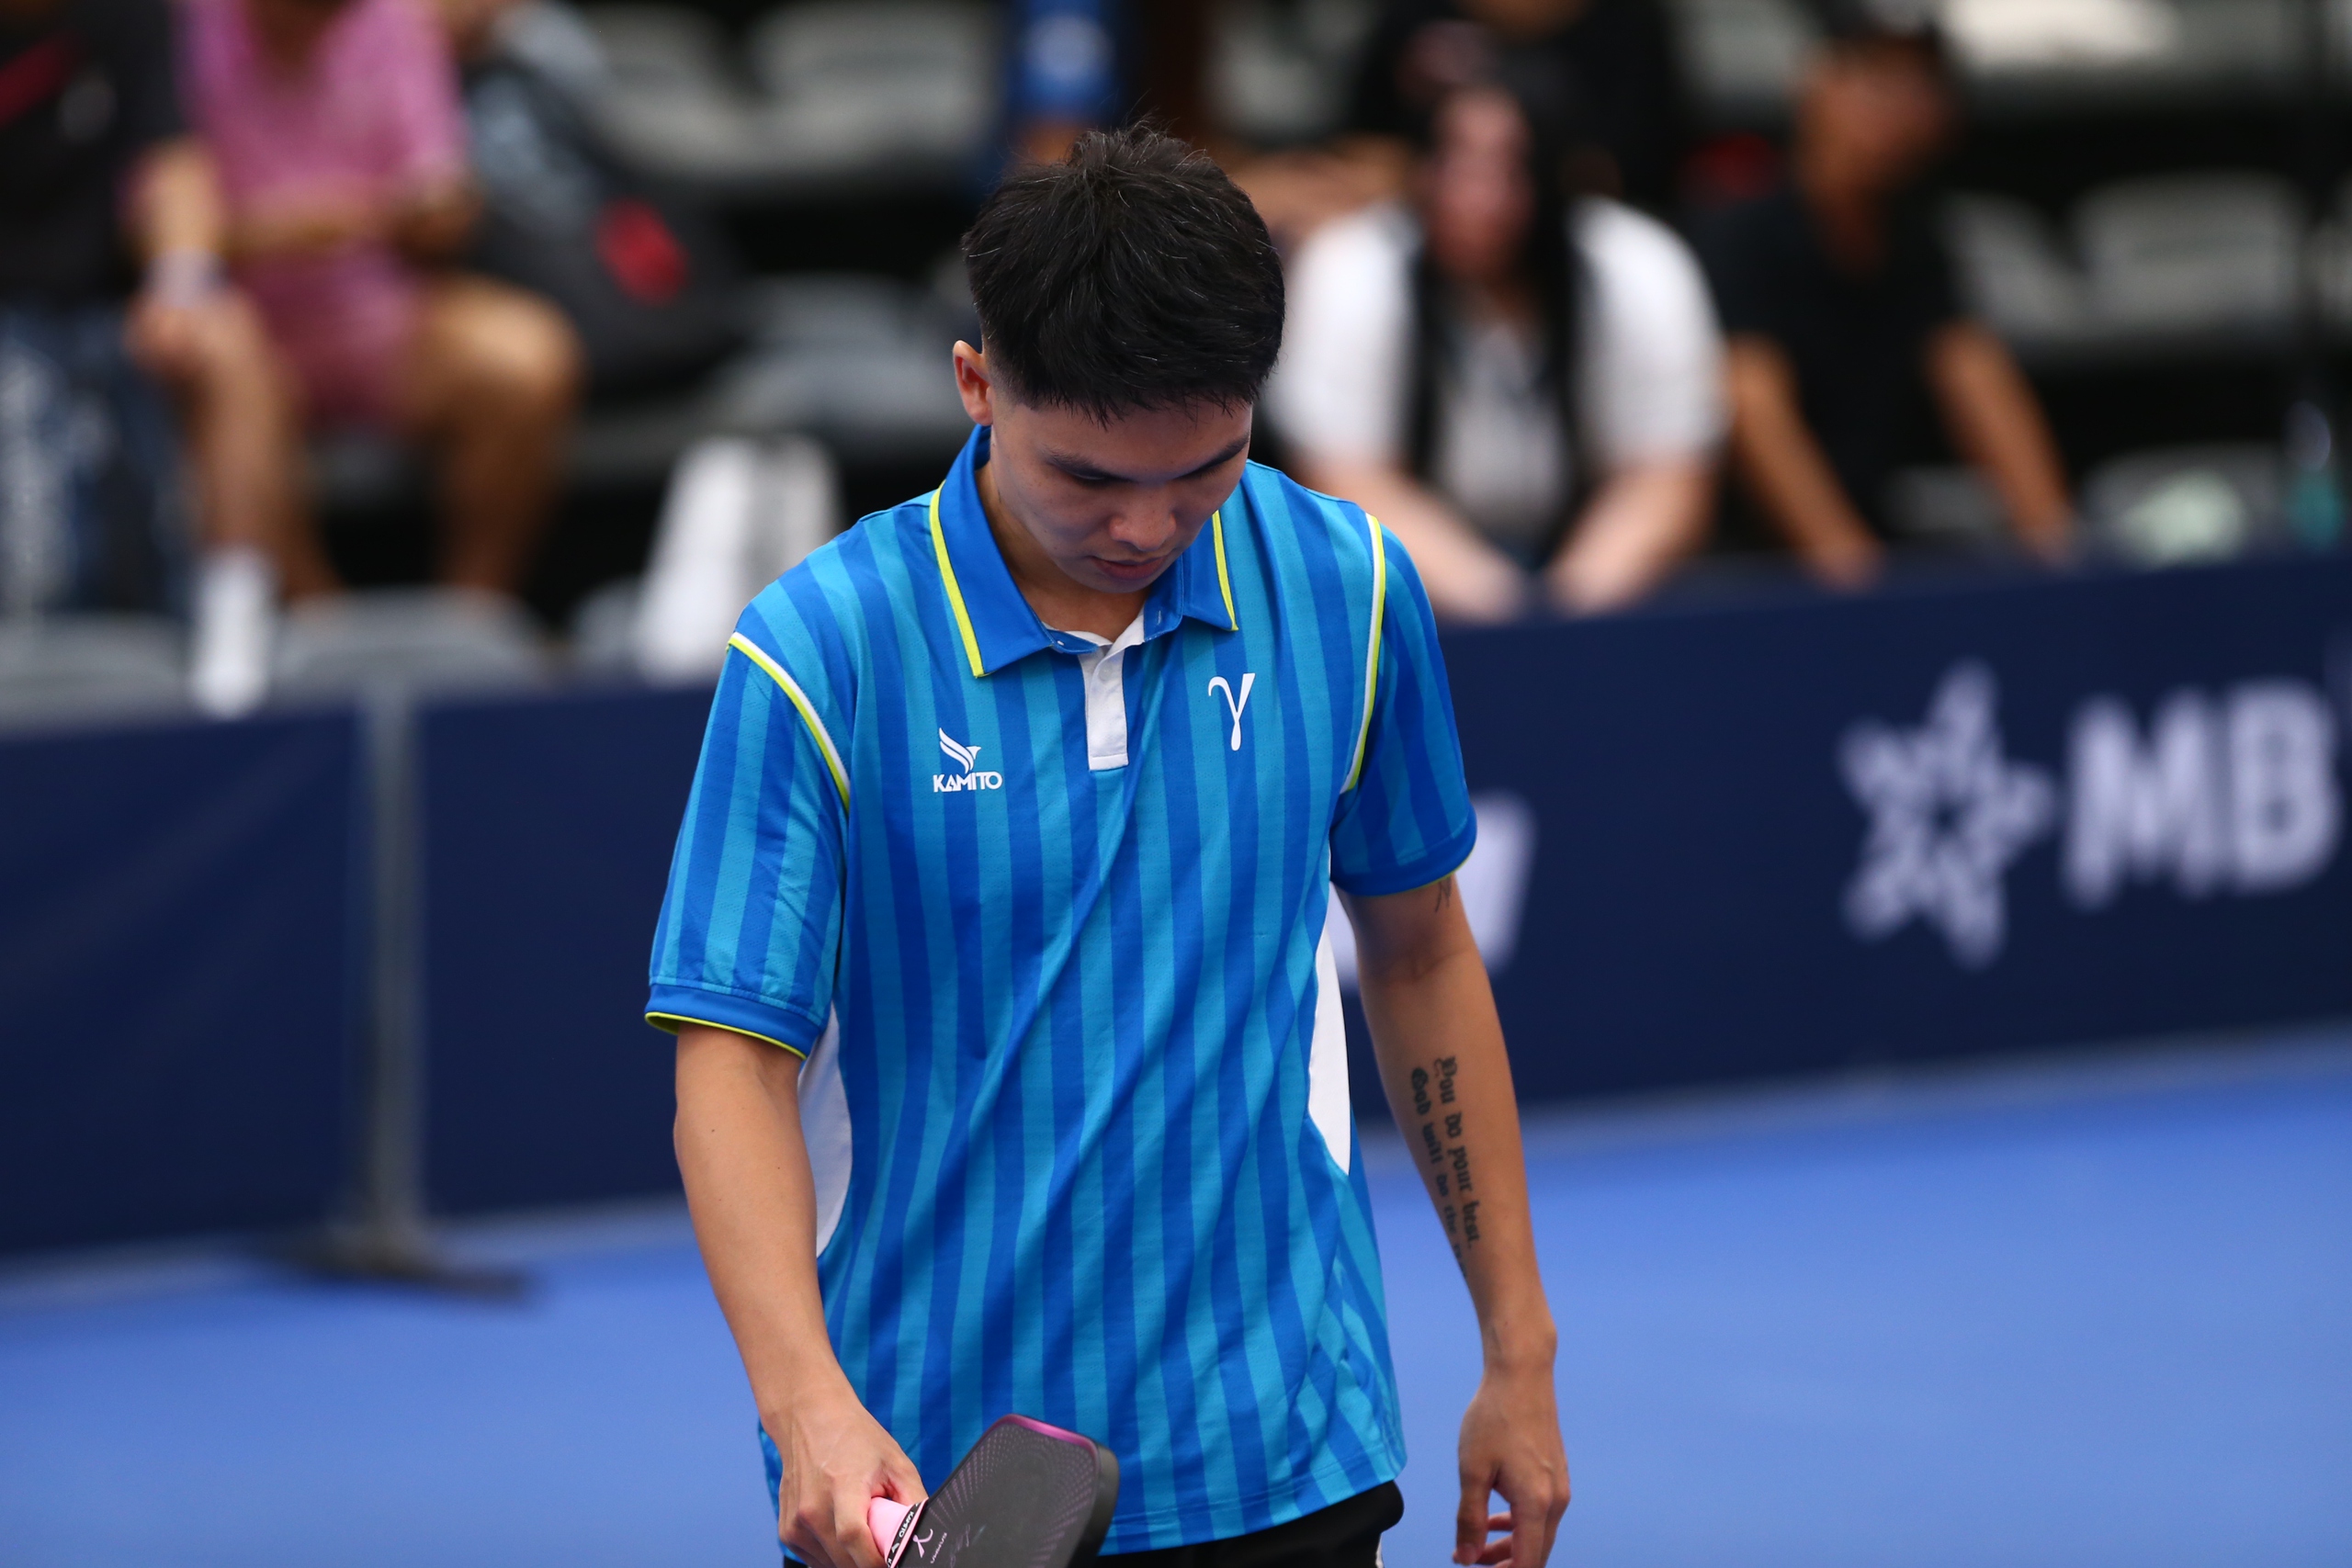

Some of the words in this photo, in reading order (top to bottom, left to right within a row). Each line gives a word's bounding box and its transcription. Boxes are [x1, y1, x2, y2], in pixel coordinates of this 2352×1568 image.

[933, 771, 1003, 793] KAMITO
[2067, 684, 2335, 905] MB
[1410, 1067, 1431, 1116] God
[1433, 1055, 1458, 1104] You
[1448, 1145, 1472, 1192] your
[899, 1511, 915, 1538] KAMITO
